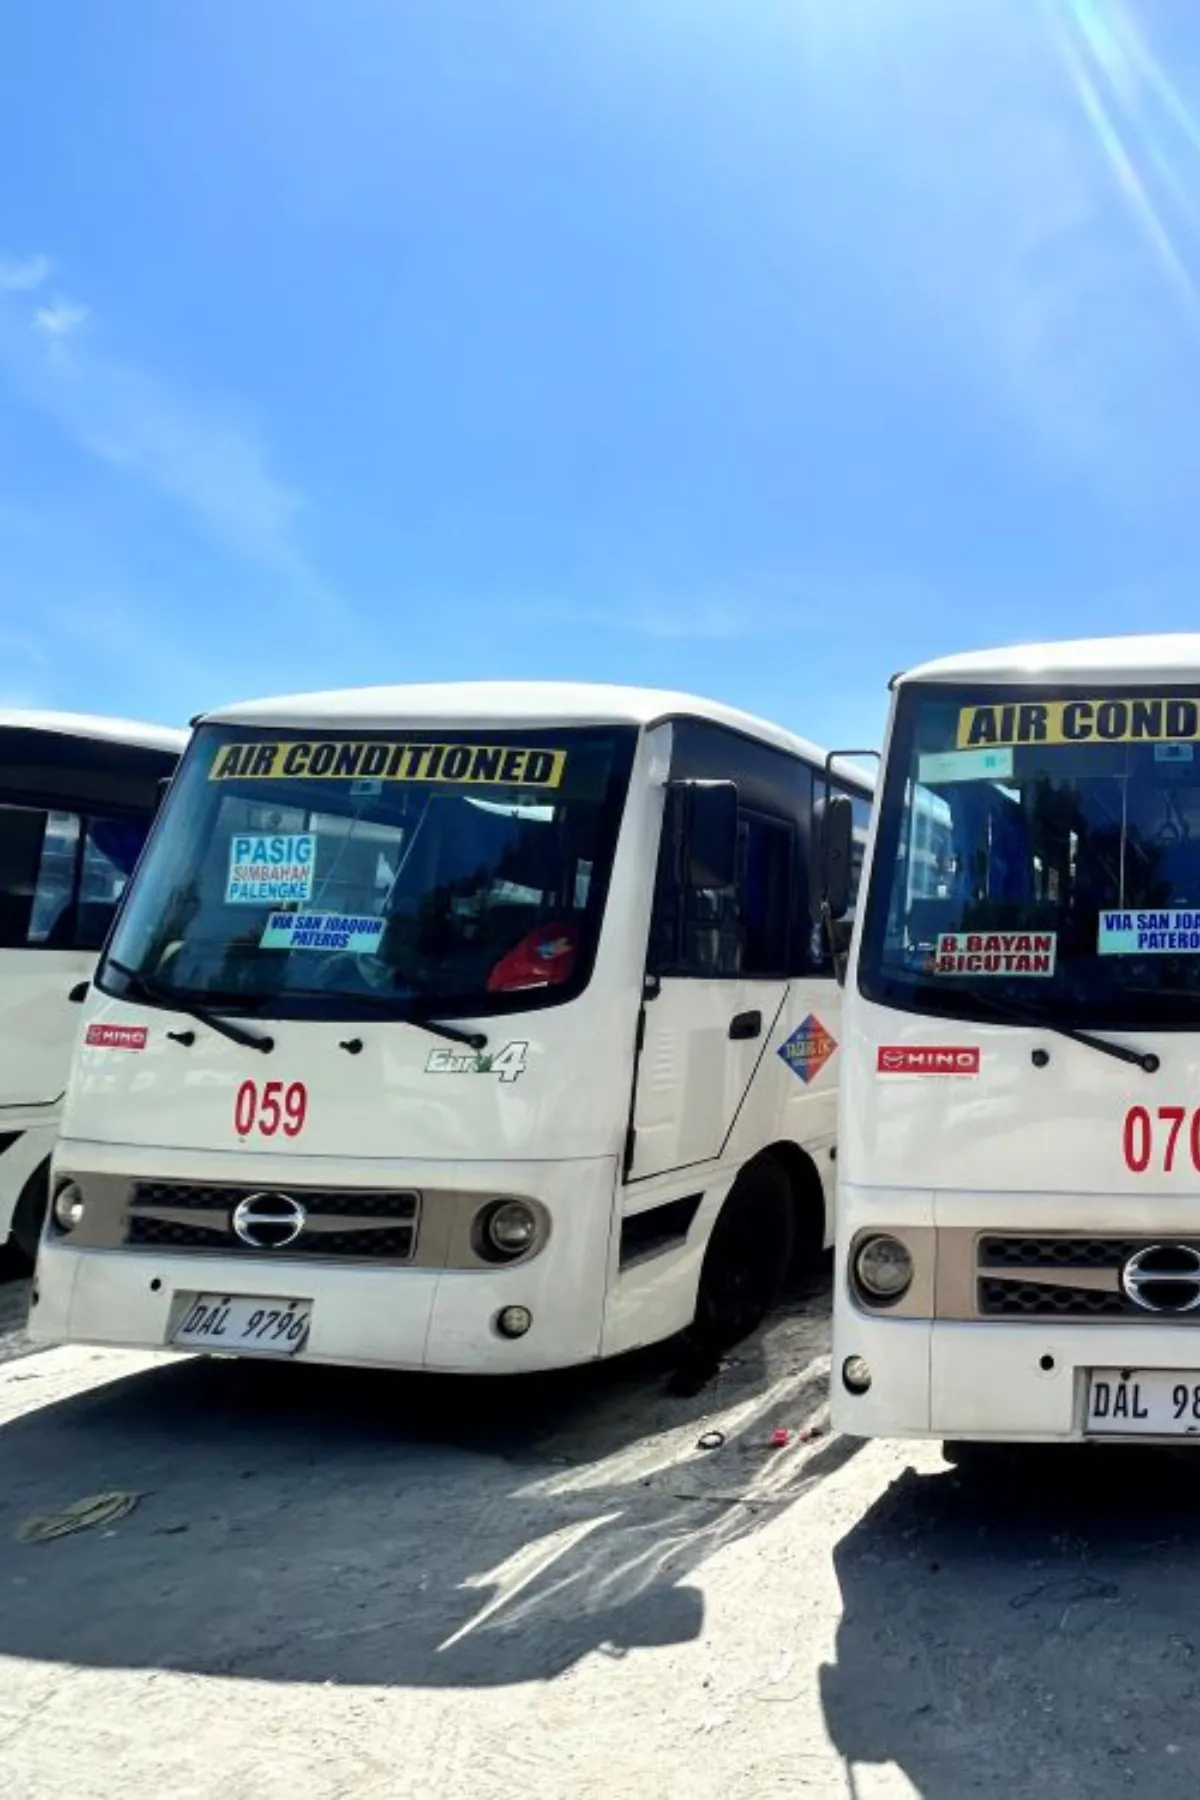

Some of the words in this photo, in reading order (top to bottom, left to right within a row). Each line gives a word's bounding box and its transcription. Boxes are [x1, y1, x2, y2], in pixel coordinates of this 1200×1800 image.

[966, 705, 1049, 745] AIR
[215, 745, 279, 778] AIR
[282, 744, 556, 783] CONDITIONED
[235, 838, 312, 864] PASIG
[233, 866, 310, 882] SIMBAHAN
[230, 883, 308, 899] PALENGKE
[271, 916, 293, 930] VIA
[295, 916, 322, 931] SAN
[324, 917, 383, 935] JOAQUIN
[1104, 914, 1132, 931] VIA
[1137, 914, 1170, 930] SAN
[290, 931, 350, 948] PATEROS
[940, 935, 1052, 953] B.BAYAN
[939, 955, 1051, 972] BICUTAN
[103, 1031, 145, 1043] HINO
[907, 1052, 975, 1067] HINO
[234, 1079, 308, 1136] 059
[182, 1304, 231, 1336] DAL
[241, 1310, 309, 1341] 9796
[1093, 1383, 1149, 1419] DAL
